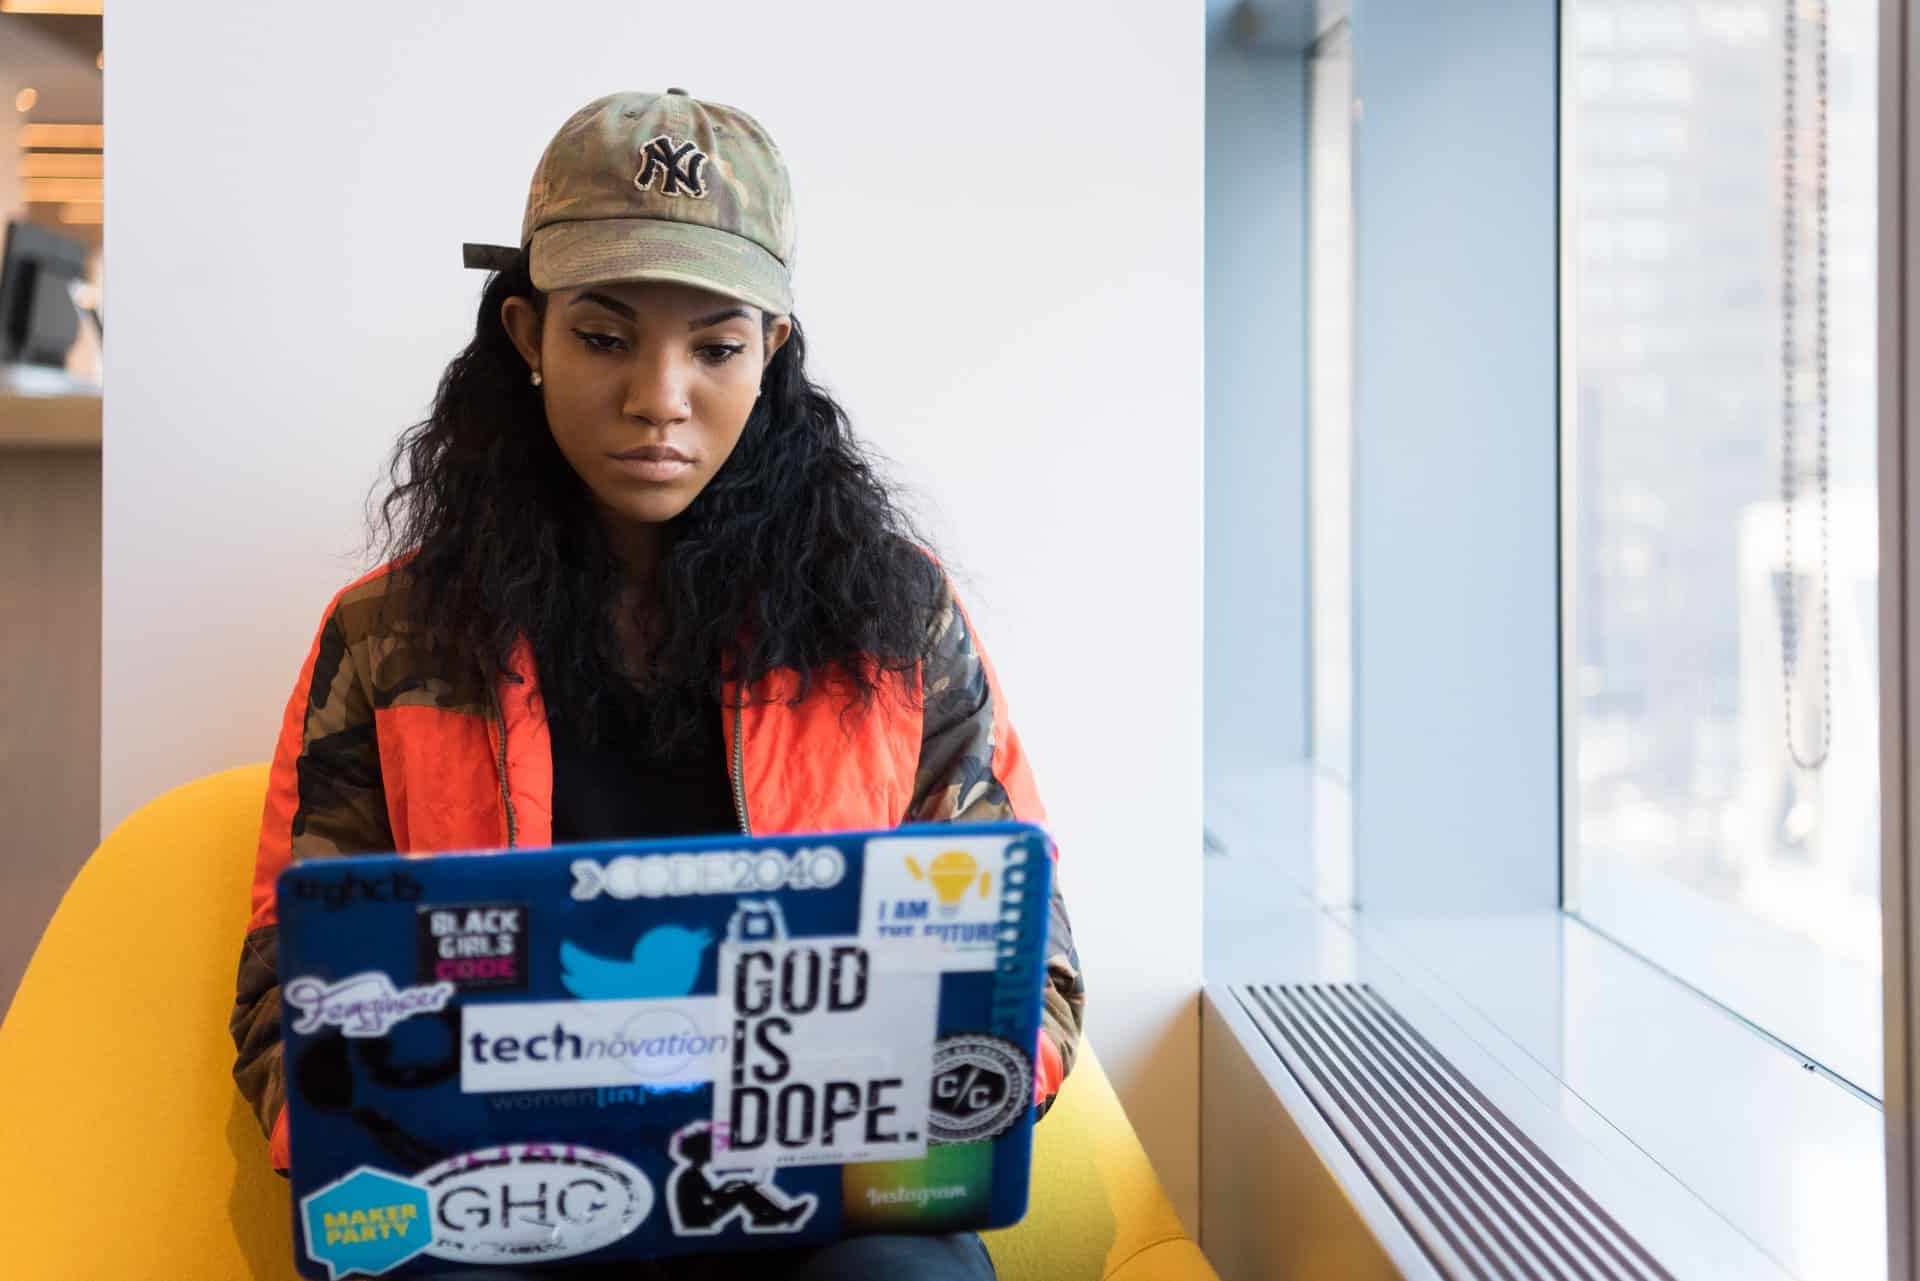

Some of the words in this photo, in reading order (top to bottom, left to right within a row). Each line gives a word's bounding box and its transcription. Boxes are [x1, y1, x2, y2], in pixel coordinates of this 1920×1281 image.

[430, 909, 520, 937] BLACK
[878, 901, 886, 920] I
[894, 900, 929, 919] AM
[438, 934, 514, 959] GIRLS
[435, 956, 515, 980] CODE
[733, 945, 869, 1018] GOD
[731, 1016, 793, 1086] IS
[730, 1078, 920, 1152] DOPE.
[865, 1184, 968, 1209] Instagram
[322, 1203, 418, 1229] MAKER
[325, 1222, 410, 1248] PARTY
